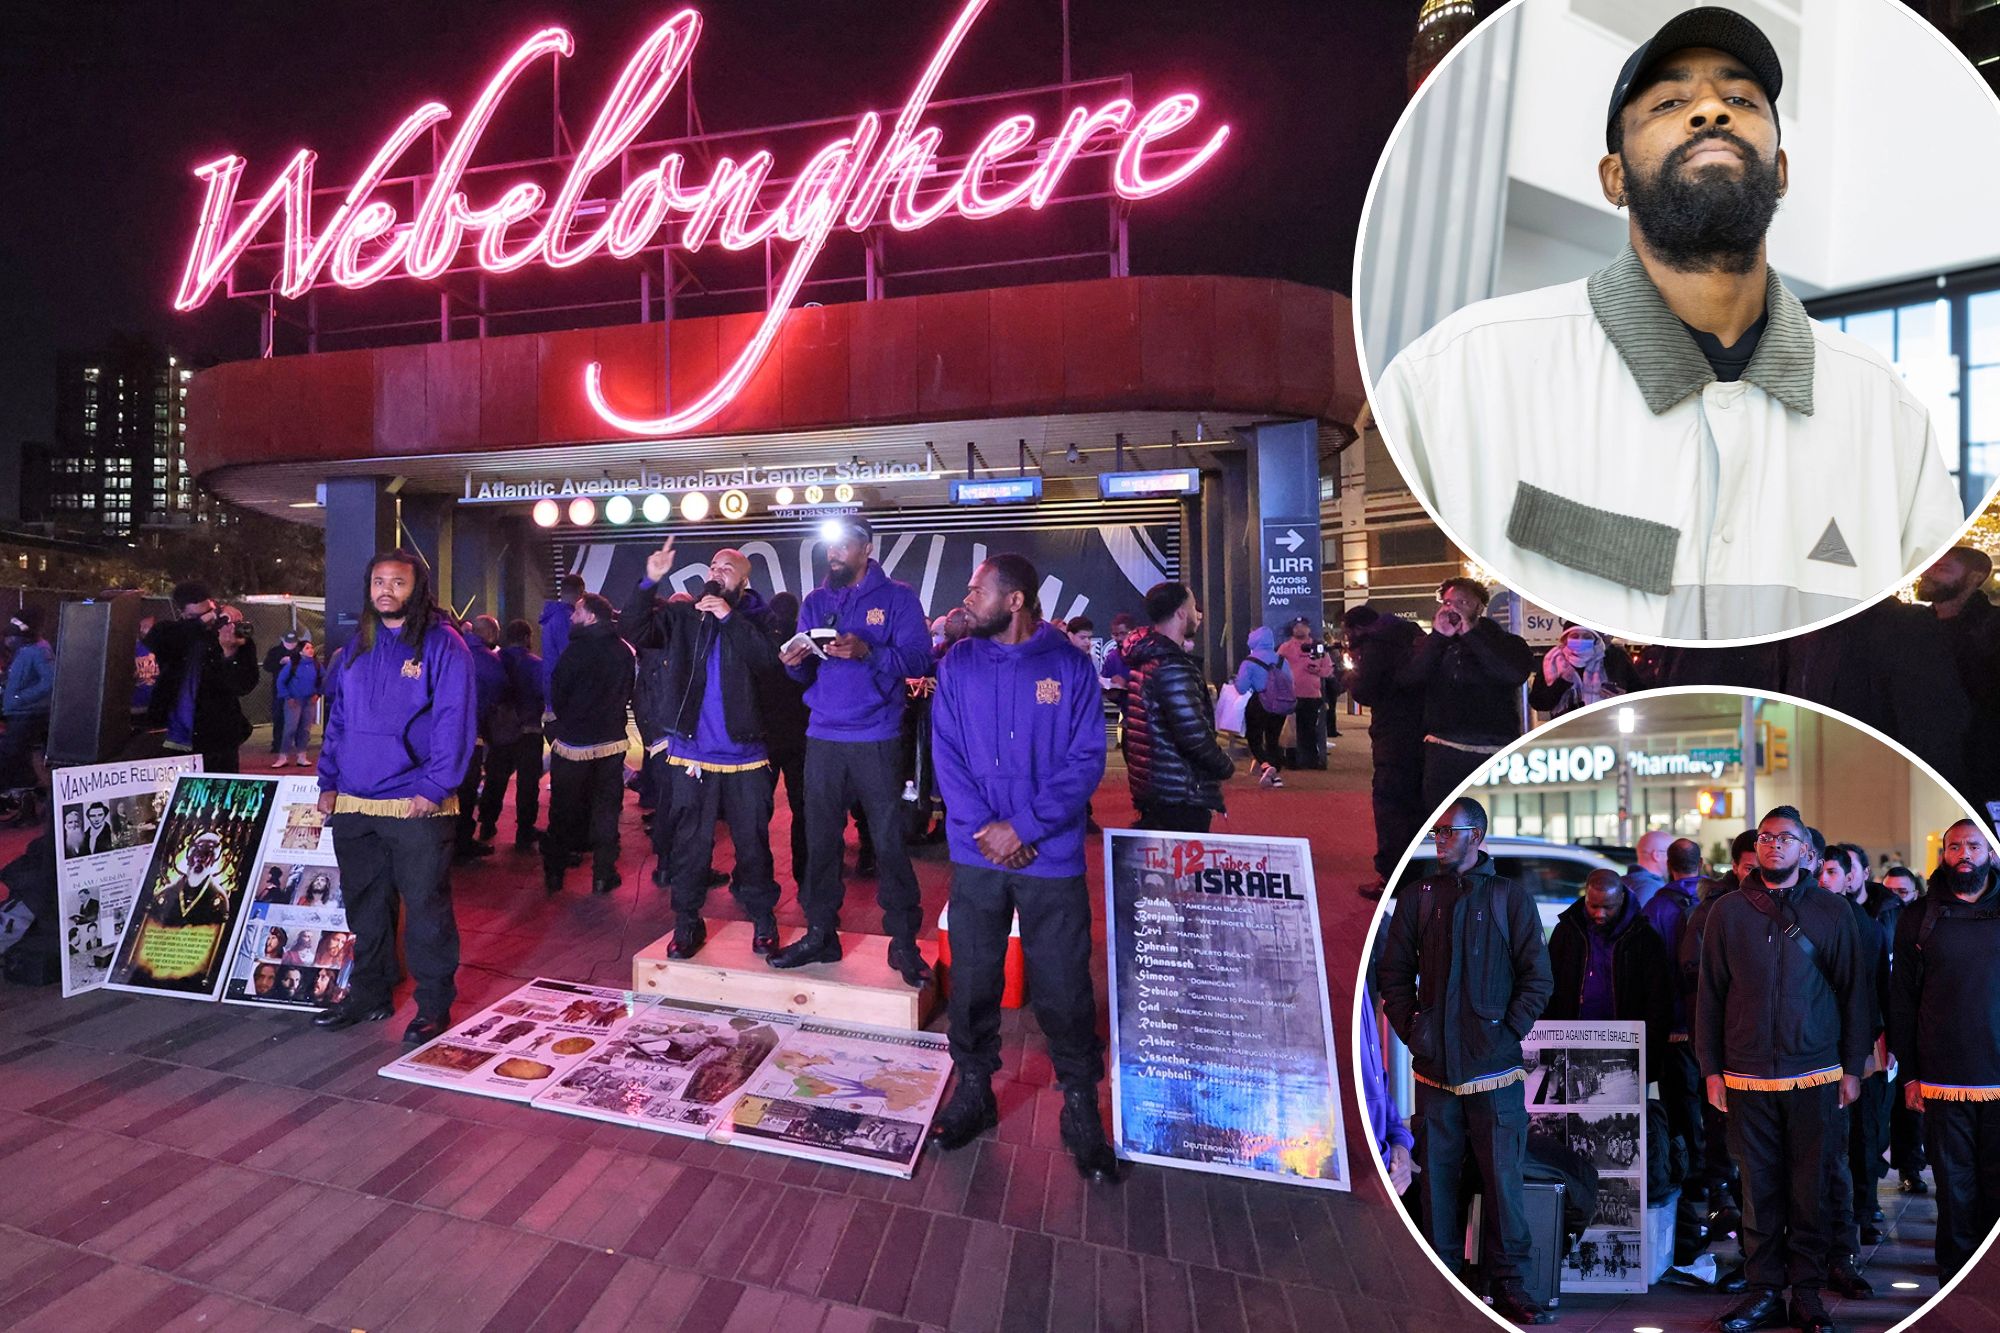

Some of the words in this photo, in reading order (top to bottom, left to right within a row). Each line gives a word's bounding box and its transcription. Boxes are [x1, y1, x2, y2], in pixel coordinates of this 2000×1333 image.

[477, 480, 555, 499] Atlantic
[560, 478, 640, 496] Avenue
[650, 465, 745, 490] Barclays
[751, 466, 826, 485] Center
[835, 460, 919, 481] Station
[725, 494, 743, 513] Q
[775, 508, 797, 518] via
[799, 507, 858, 520] passage
[1268, 557, 1314, 573] LIRR
[1268, 575, 1308, 585] Across
[1268, 585, 1312, 595] Atlantic
[1268, 596, 1290, 606] Ave
[1527, 615, 1554, 631] Sky
[1137, 847, 1168, 870] The
[1171, 840, 1205, 879] 12
[1203, 849, 1251, 872] Tribes
[1255, 856, 1268, 874] of
[1194, 867, 1305, 900] ISRAEL
[1133, 896, 1171, 908] Judah
[1133, 911, 1185, 923] Benjamin
[1133, 925, 1162, 937] Levi
[1134, 940, 1179, 954] Ephraim
[1134, 954, 1194, 969] Manasseh
[1134, 969, 1175, 982] Simeon
[1138, 985, 1179, 998] Zebulon
[1138, 1000, 1160, 1013] Gad
[1138, 1017, 1178, 1031] Reuben
[1139, 1034, 1176, 1048] Asher
[1527, 1029, 1565, 1041] COMMITTED
[1566, 1029, 1593, 1041] AGAINST
[1594, 1030, 1606, 1041] THE
[1139, 1051, 1190, 1065] Issachar
[1138, 1066, 1192, 1081] Naphtali
